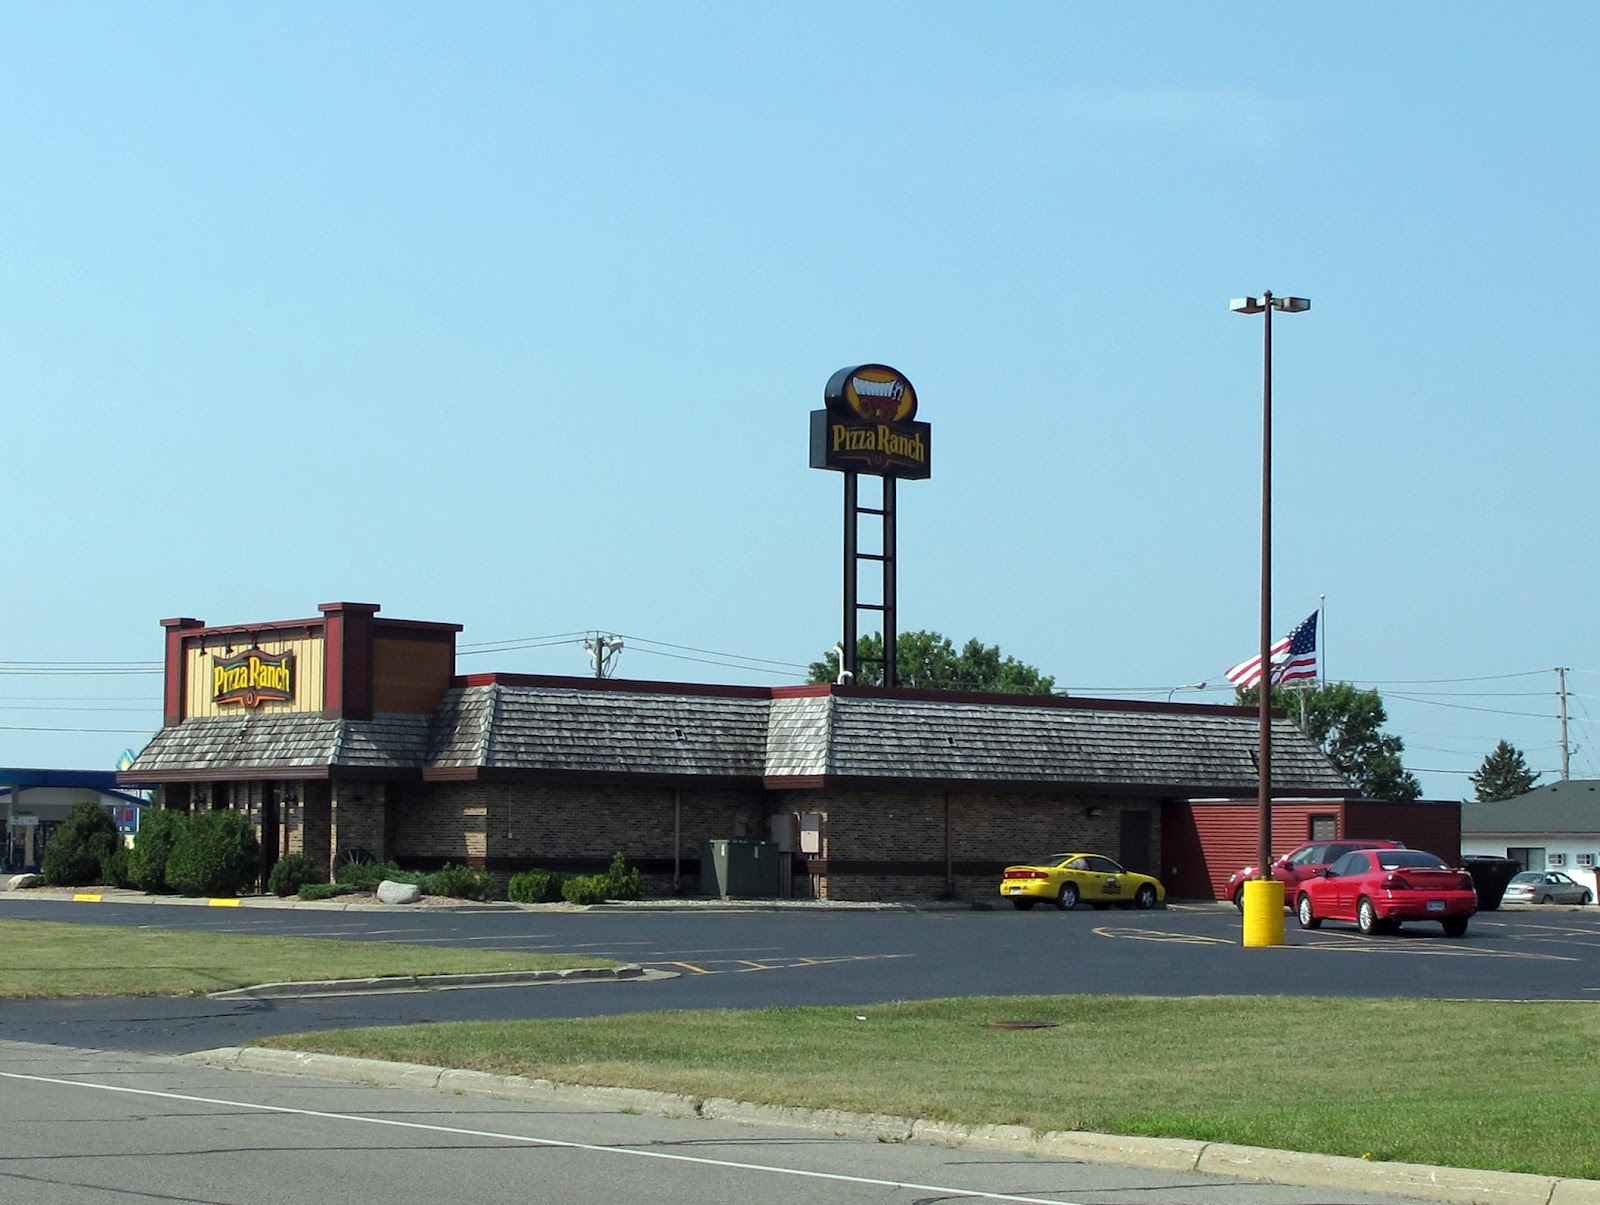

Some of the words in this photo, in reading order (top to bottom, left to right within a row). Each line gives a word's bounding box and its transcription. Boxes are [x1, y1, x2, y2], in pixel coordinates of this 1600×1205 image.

[832, 425, 876, 451] Pizza
[877, 424, 924, 463] Ranch
[214, 666, 248, 697] Pizza
[249, 656, 290, 692] Ranch
